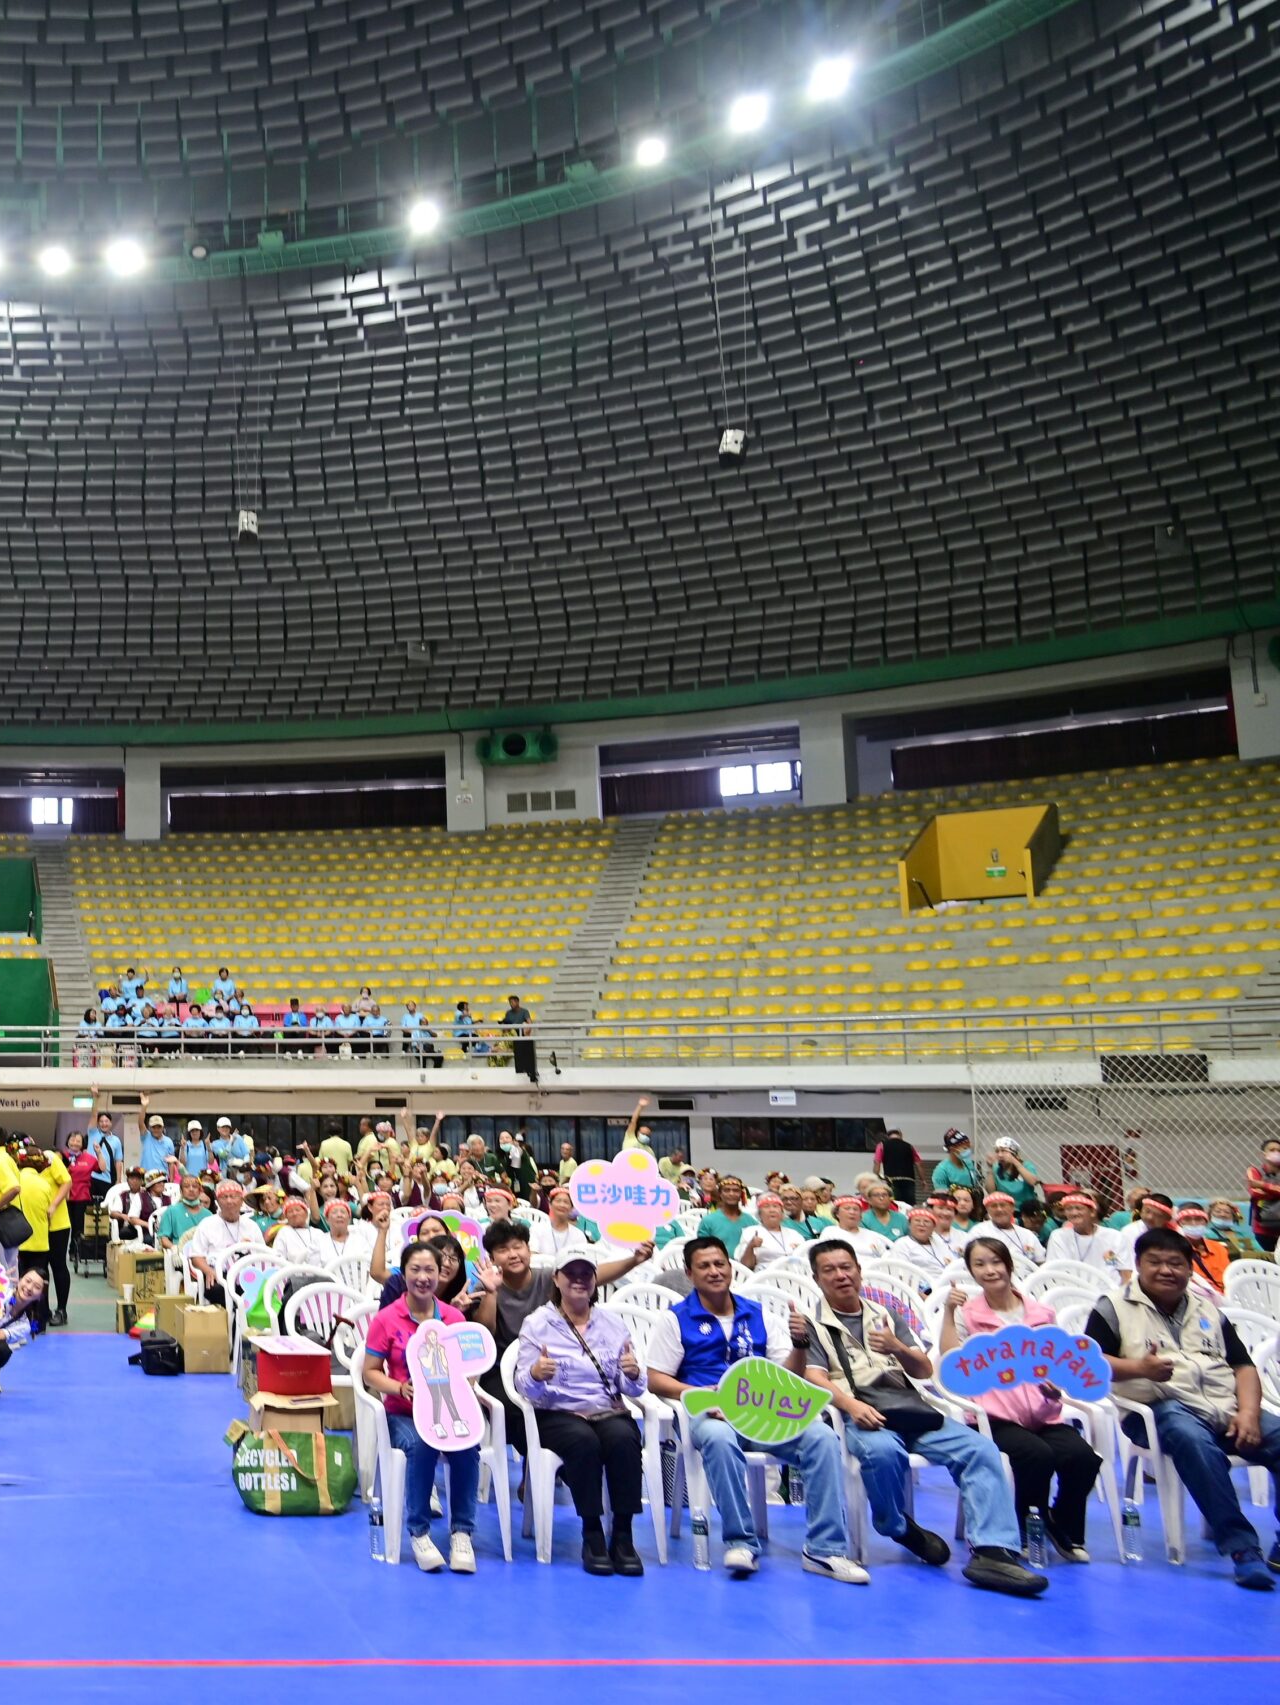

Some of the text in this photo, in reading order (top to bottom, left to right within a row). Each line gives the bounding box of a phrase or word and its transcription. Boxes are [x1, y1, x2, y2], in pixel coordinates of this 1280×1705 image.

[21, 1099, 40, 1109] gate
[577, 1183, 671, 1206] 巴沙哇力
[955, 1338, 1104, 1389] taranapaw
[736, 1377, 812, 1420] Bulay
[238, 1472, 290, 1492] BOTTLES
